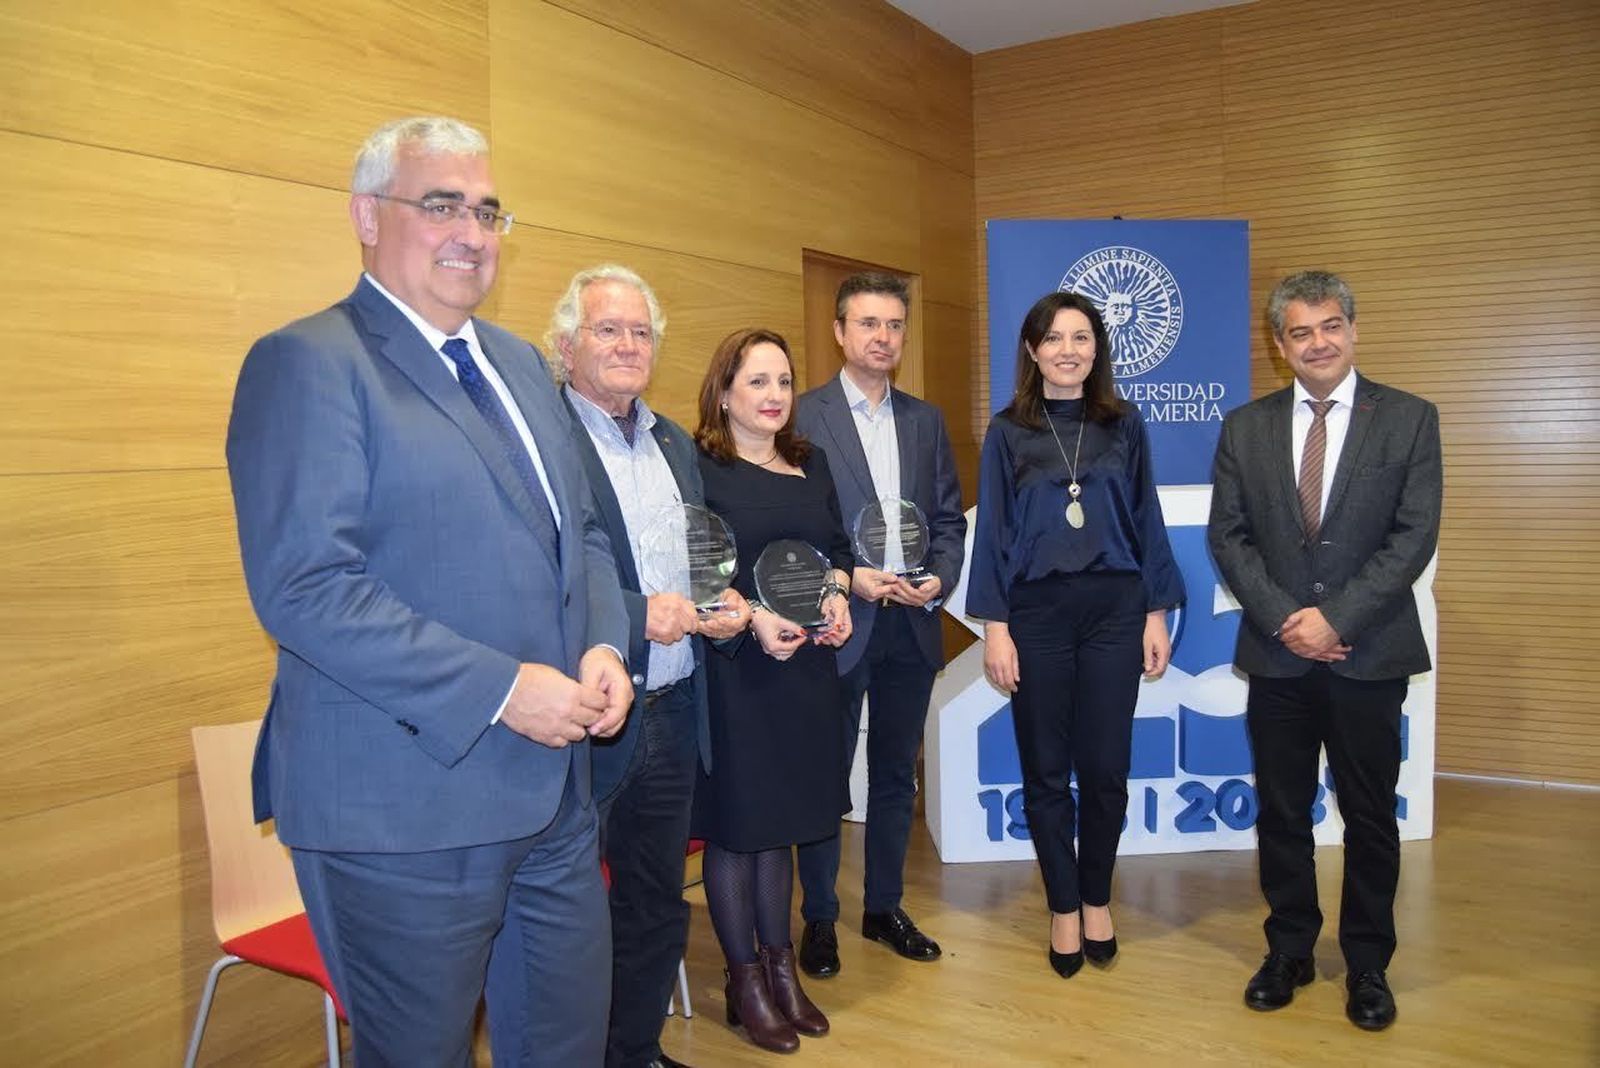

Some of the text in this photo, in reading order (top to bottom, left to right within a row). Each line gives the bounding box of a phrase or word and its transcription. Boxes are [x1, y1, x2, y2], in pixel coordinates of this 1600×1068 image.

[1070, 249, 1118, 281] LUMINE
[1121, 249, 1177, 297] SAPIENTIA
[1122, 305, 1181, 376] ALMERIENSIS
[1113, 382, 1225, 401] IVERSIDAD
